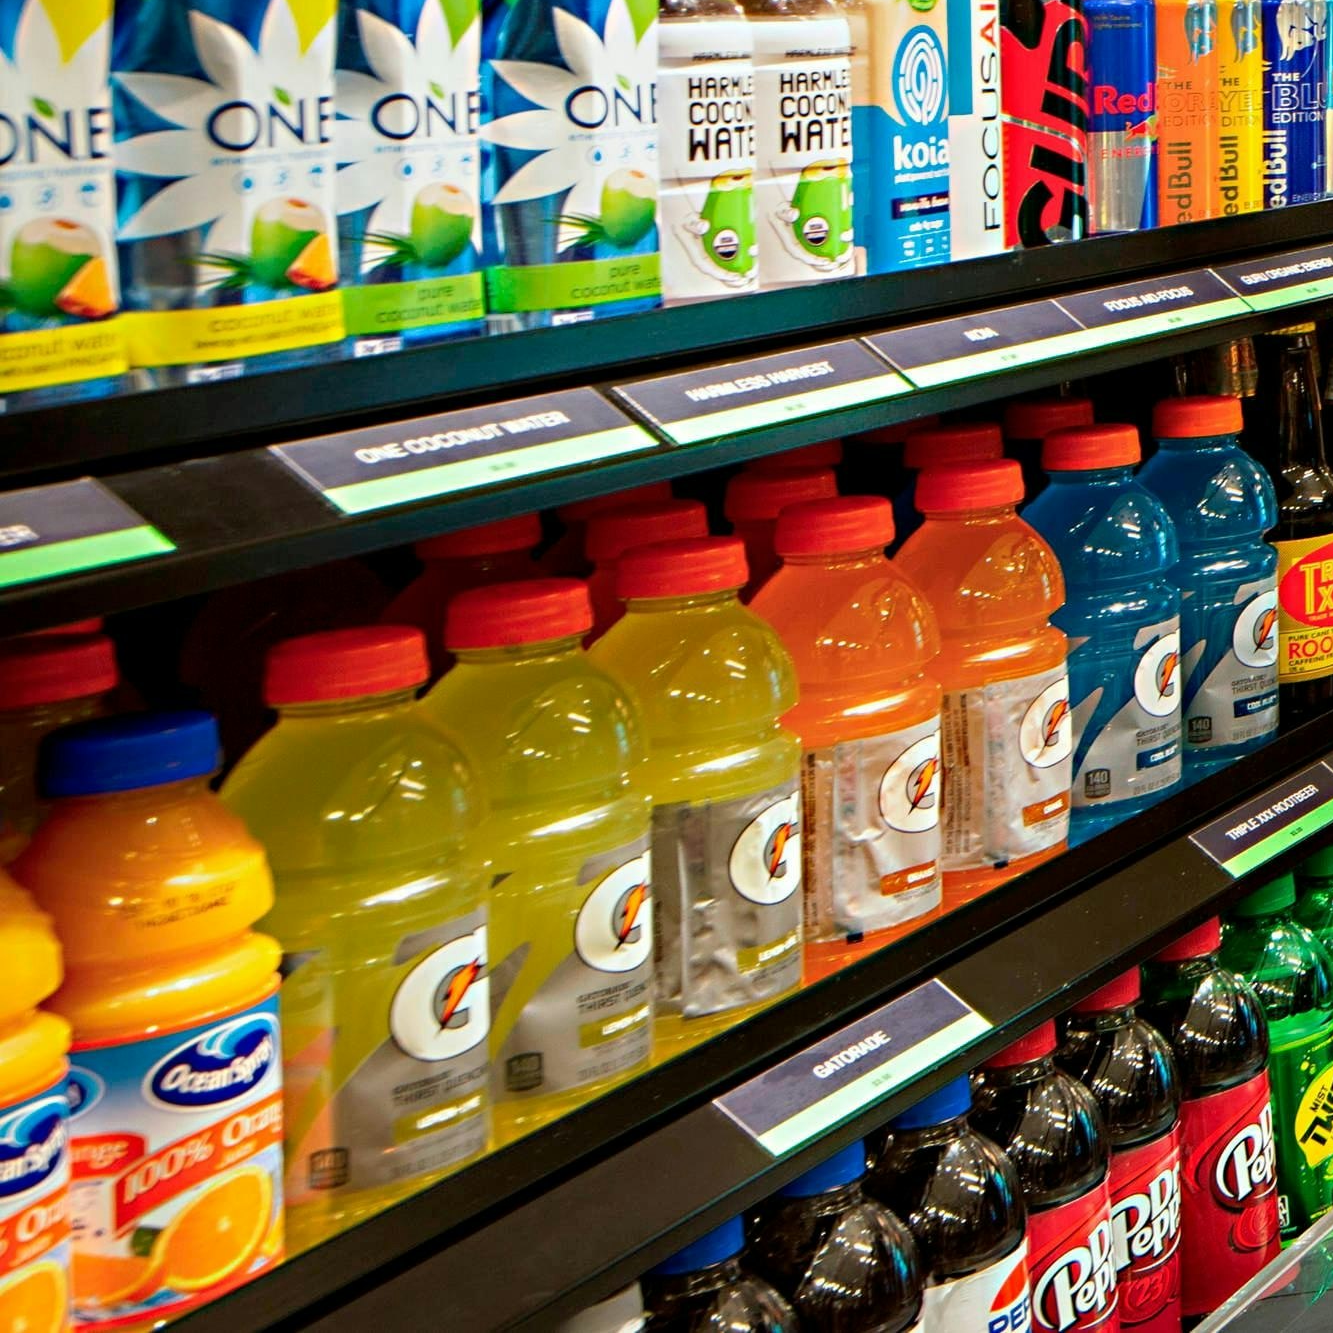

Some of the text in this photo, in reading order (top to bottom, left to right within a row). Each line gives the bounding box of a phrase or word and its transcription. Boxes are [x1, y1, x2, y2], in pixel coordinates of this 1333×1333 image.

[1272, 73, 1300, 82] THE
[1094, 85, 1154, 115] Red
[205, 94, 333, 152] ONE
[369, 90, 480, 141] ONE
[893, 135, 949, 172] koia
[608, 262, 641, 281] pure
[1239, 273, 1266, 286] GURU
[1266, 264, 1302, 282] ORGANIC
[416, 283, 456, 303] pure
[571, 279, 630, 301] coconut
[375, 304, 437, 324] coconut
[1103, 295, 1141, 313] FOCUS
[683, 360, 835, 403] HARMLESS HARVEST
[354, 411, 570, 465] ONE COCONUT WATER
[1288, 632, 1310, 642] PURE
[1288, 653, 1323, 666] CAFFEINE
[1232, 681, 1258, 695] THIRST
[1136, 735, 1158, 747] THIRST
[1224, 814, 1260, 841] TRIPLE
[1271, 784, 1319, 818] ROOTBEER
[812, 1030, 891, 1080] GATORADE
[1309, 1084, 1328, 1113] MIST
[122, 1132, 215, 1206] 100%
